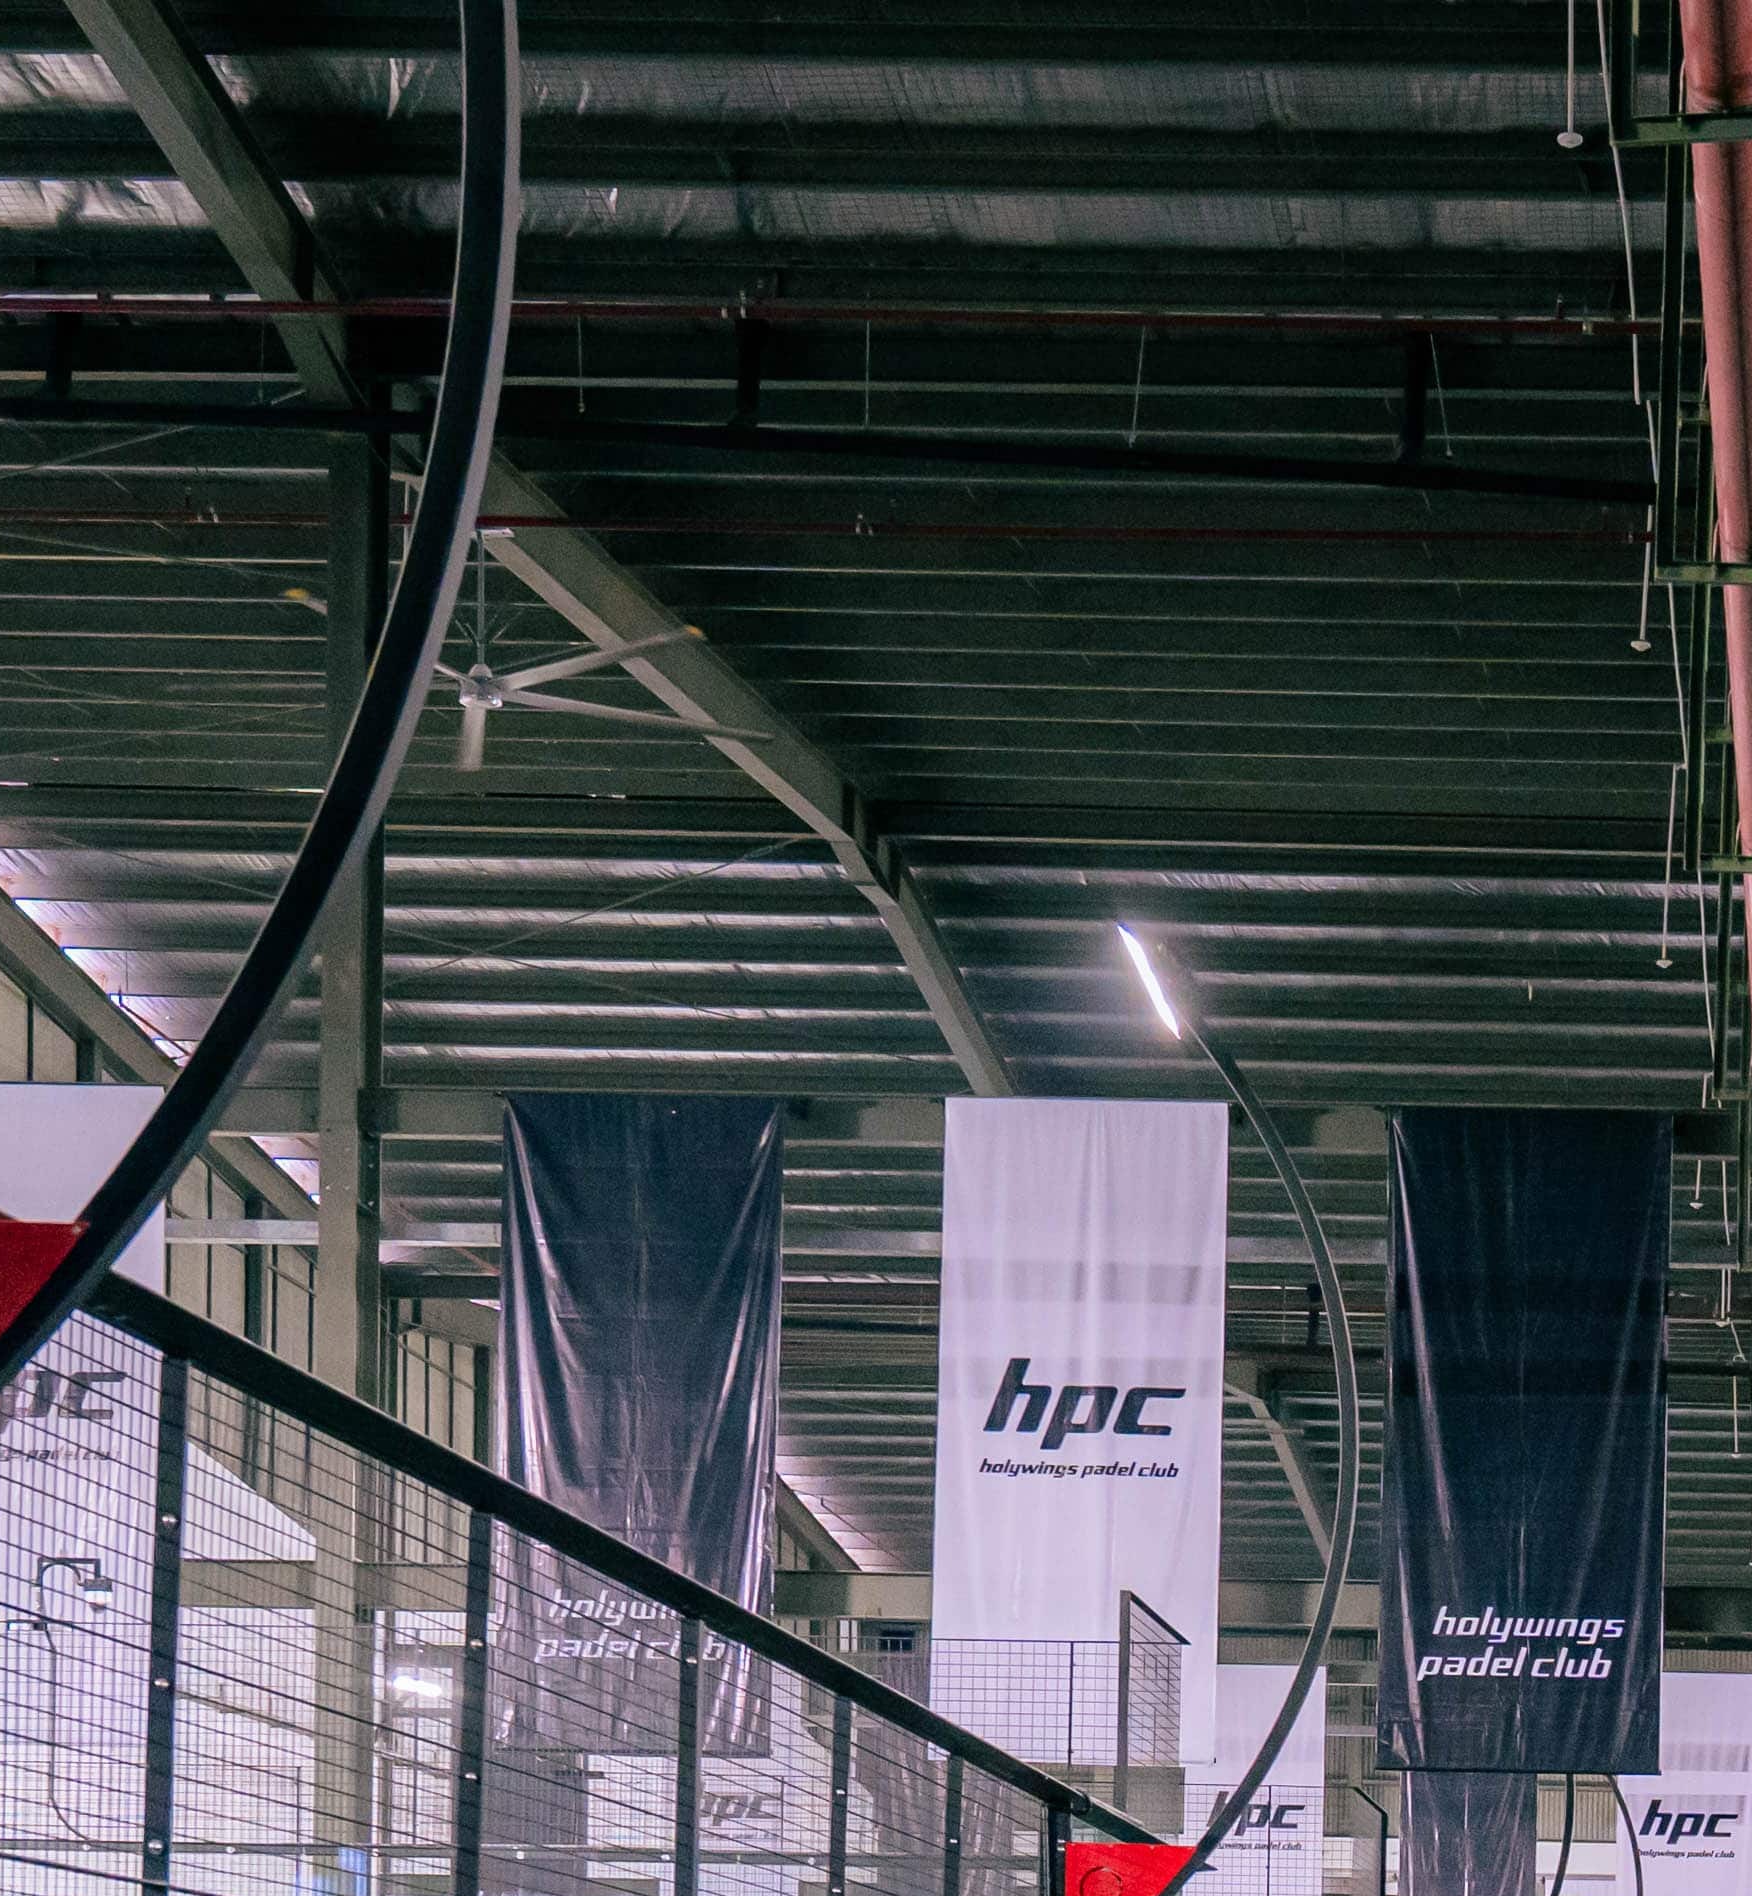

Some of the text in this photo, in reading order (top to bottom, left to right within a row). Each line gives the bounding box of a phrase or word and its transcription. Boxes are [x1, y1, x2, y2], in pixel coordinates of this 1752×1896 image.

[983, 1358, 1186, 1450] hpc
[979, 1458, 1179, 1479] holywings padel club
[1433, 1606, 1626, 1644] holywings
[534, 1629, 726, 1664] padel clb
[1417, 1646, 1613, 1681] padel club
[1639, 1799, 1738, 1845] hpc
